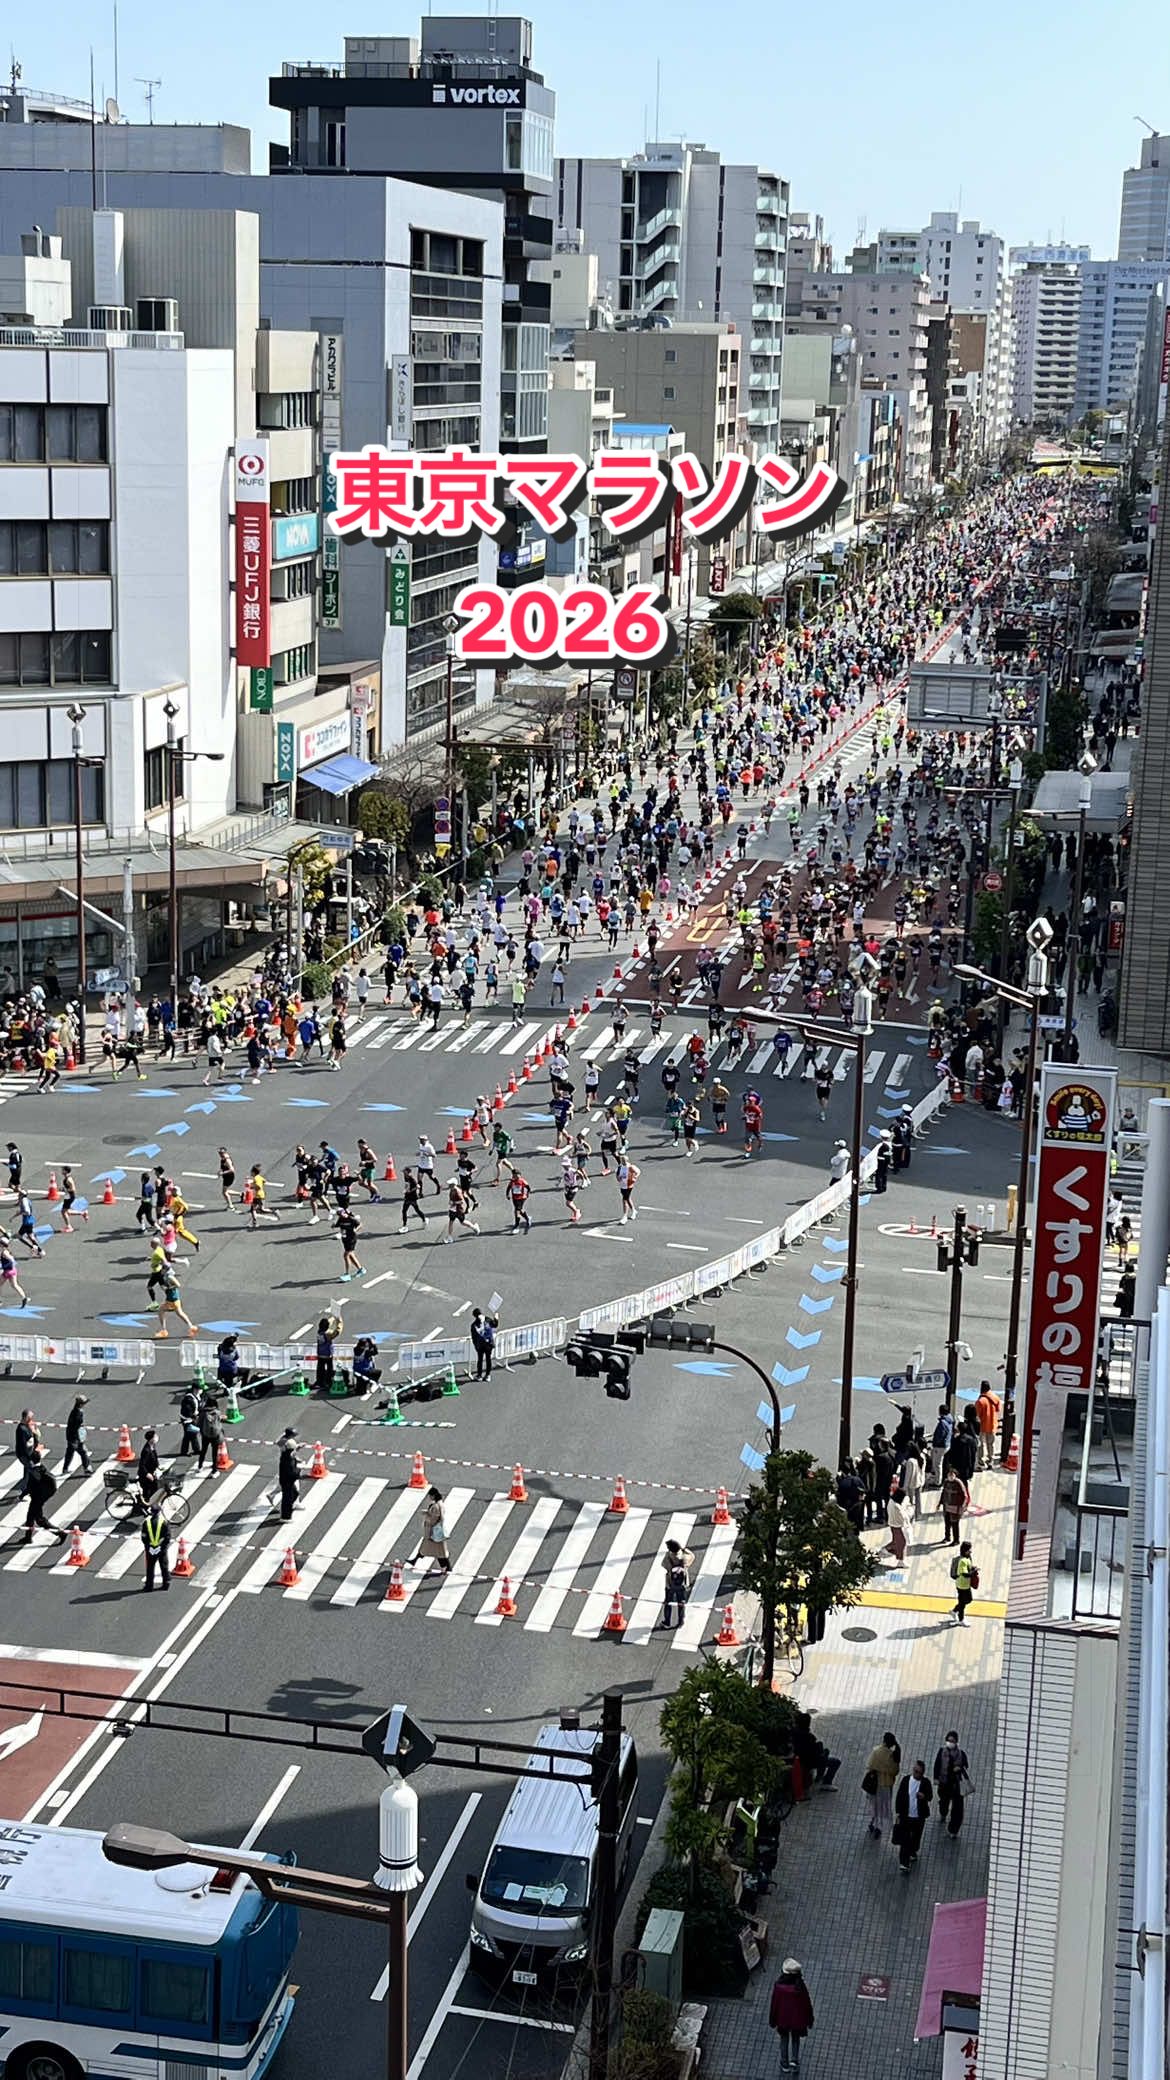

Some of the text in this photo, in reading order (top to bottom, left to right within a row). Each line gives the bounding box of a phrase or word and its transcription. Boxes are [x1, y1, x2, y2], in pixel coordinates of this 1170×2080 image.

[450, 85, 520, 104] vortex
[239, 478, 265, 487] MUFG
[242, 516, 260, 639] 三菱UFJ銀行
[280, 731, 292, 772] NOVA
